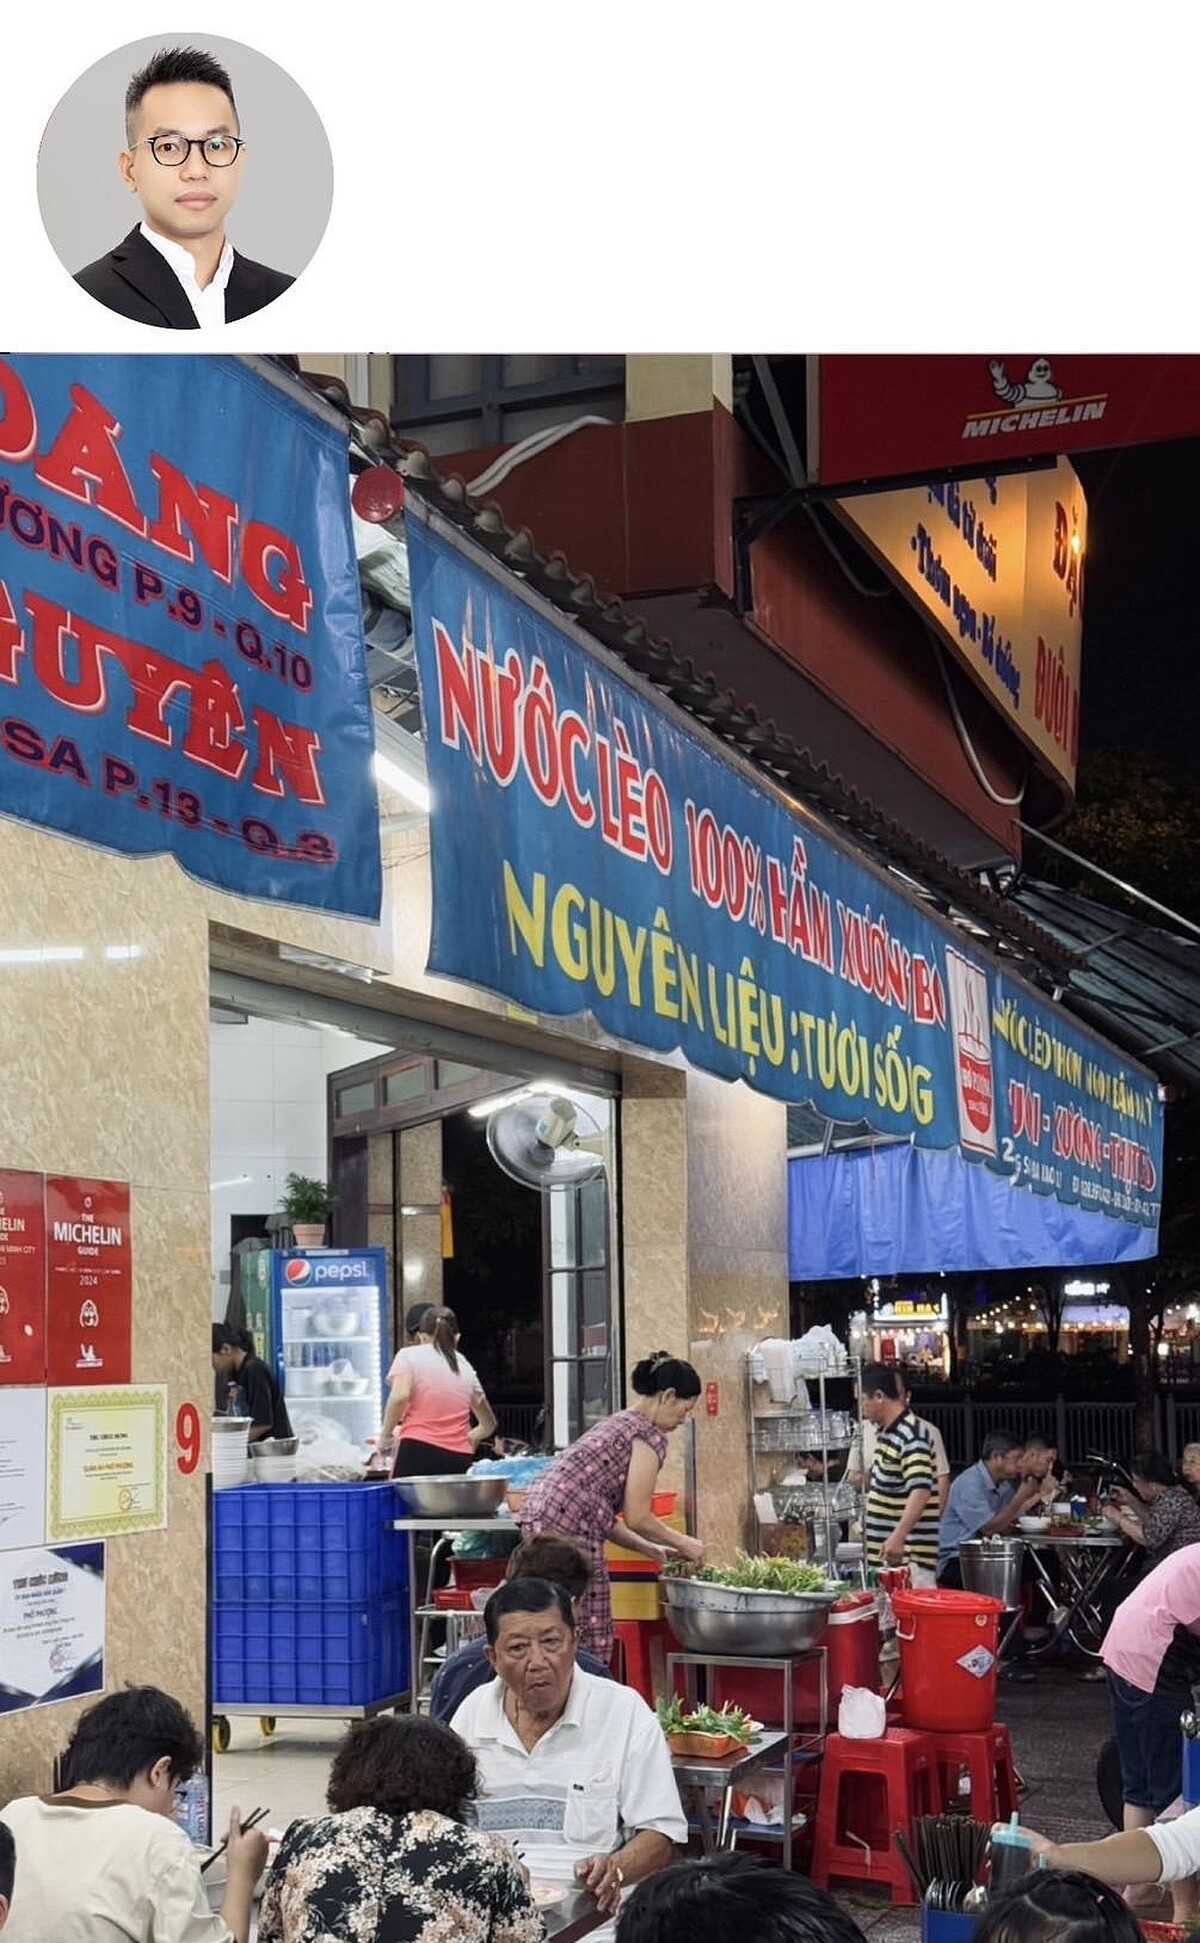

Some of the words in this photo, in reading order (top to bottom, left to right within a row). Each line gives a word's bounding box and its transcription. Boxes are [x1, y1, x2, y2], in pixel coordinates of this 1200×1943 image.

[961, 401, 1107, 439] MICHELIN
[0, 481, 119, 592] ƠNG
[134, 562, 202, 626] P.9
[236, 620, 313, 690] Q.10
[2, 717, 91, 787] SA
[103, 755, 203, 829] P.13
[431, 616, 597, 829] NƯỚC
[595, 717, 674, 876] LÈO
[684, 798, 766, 937] 100%
[503, 859, 705, 1033] NGUYÊN
[707, 956, 785, 1078] LIỆU
[0, 1217, 25, 1232] ELIN
[54, 1221, 122, 1246] MICHELIN
[79, 1275, 98, 1286] 2024
[315, 1261, 368, 1282] pepsi
[177, 1402, 201, 1475] 9
